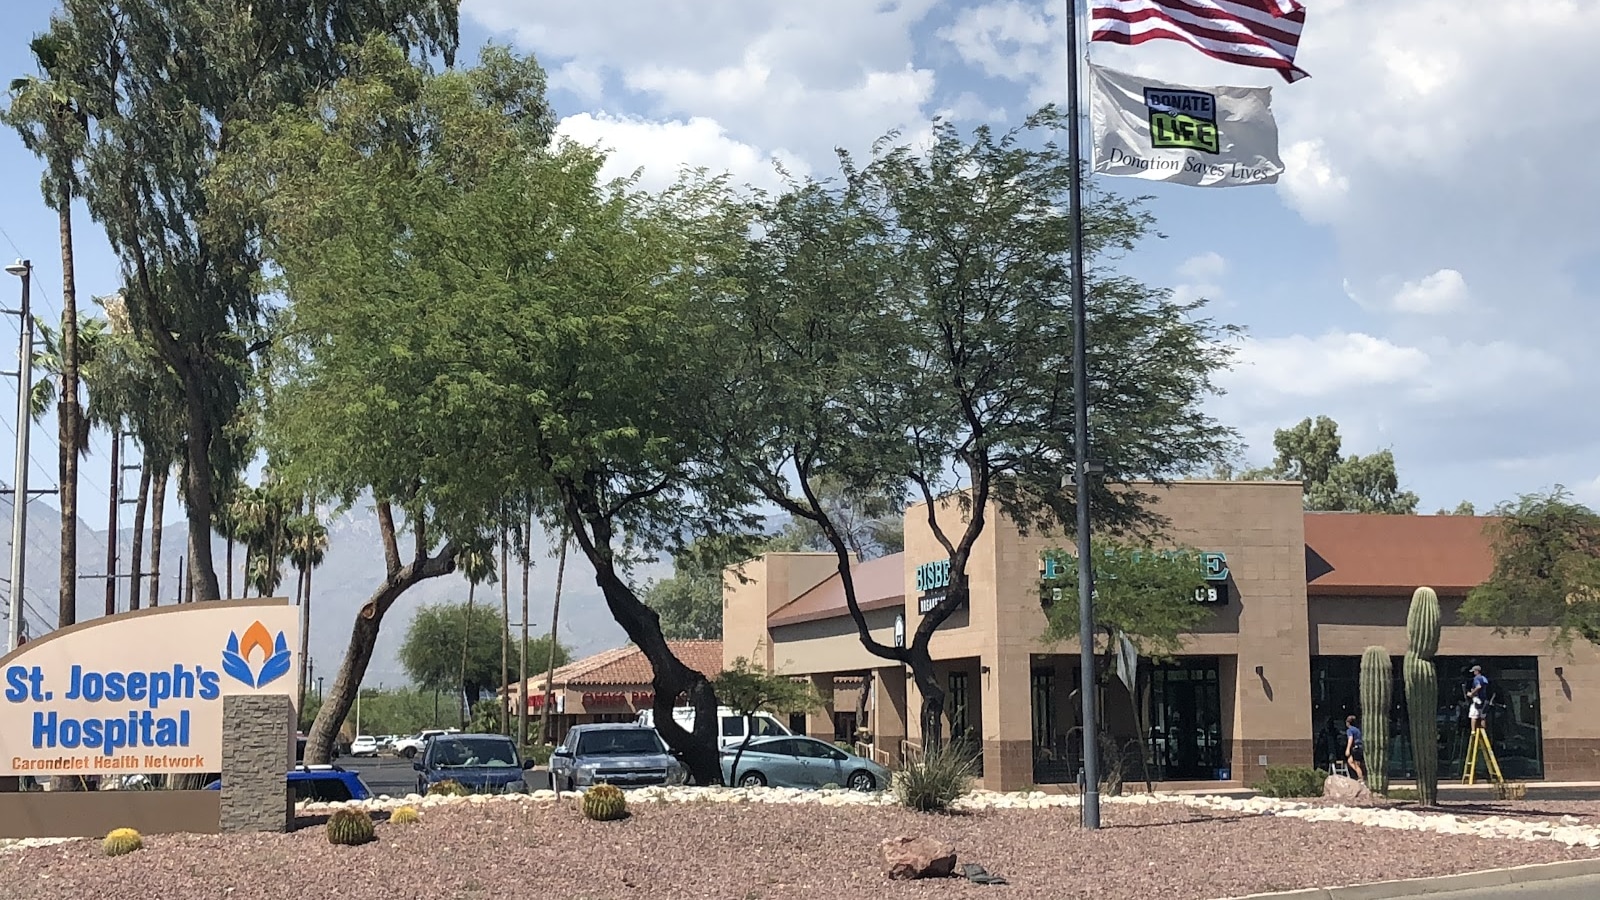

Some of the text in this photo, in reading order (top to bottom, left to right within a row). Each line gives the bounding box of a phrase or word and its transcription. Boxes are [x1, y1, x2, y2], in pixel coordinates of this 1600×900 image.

[1150, 94, 1210, 112] DONATE
[1156, 117, 1214, 147] LIFE
[1110, 148, 1268, 180] Donation Saves Lives
[916, 559, 950, 592] BISBE
[5, 664, 220, 708] St. Joseph's
[32, 710, 190, 756] Hospital
[12, 754, 204, 770] Carondelet Health Network
